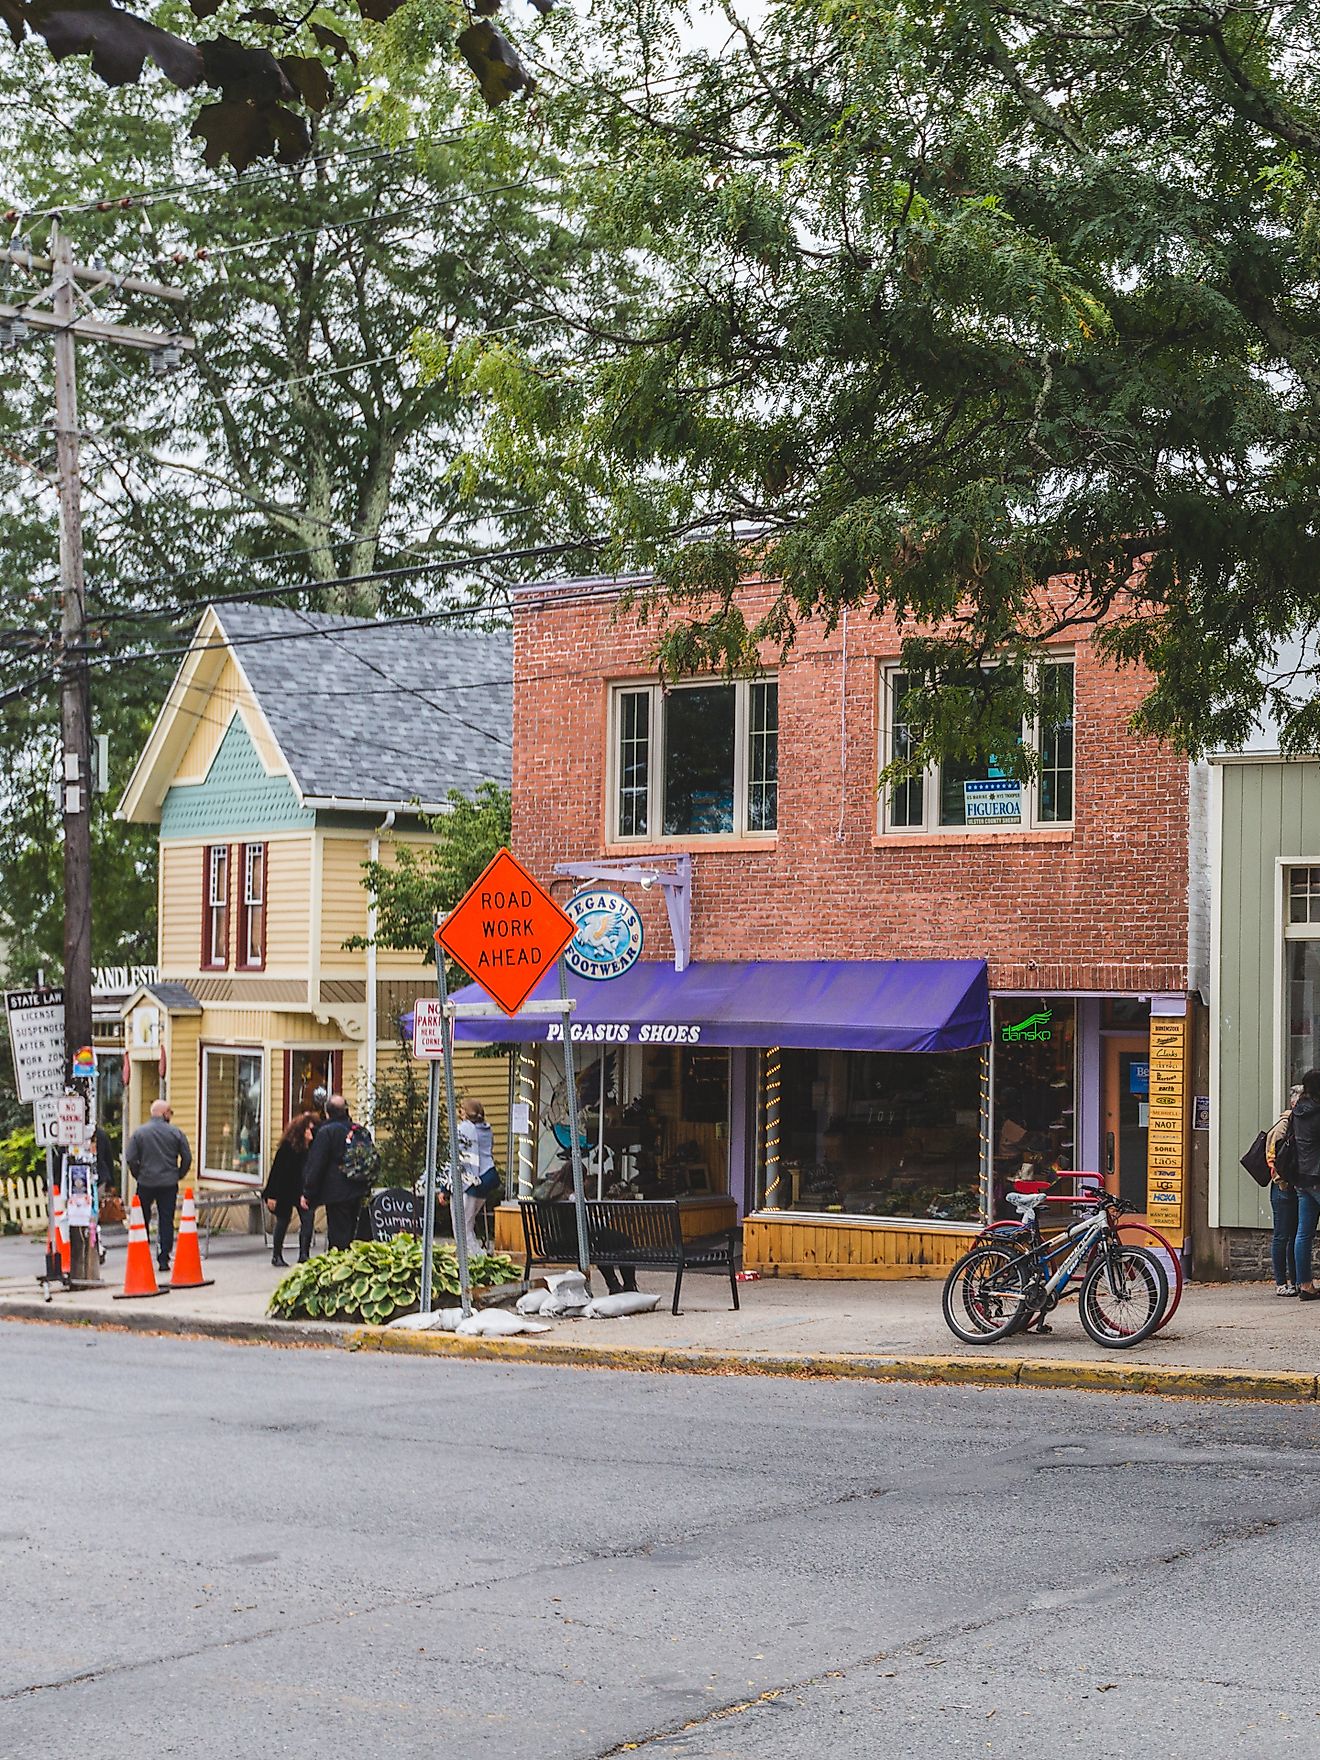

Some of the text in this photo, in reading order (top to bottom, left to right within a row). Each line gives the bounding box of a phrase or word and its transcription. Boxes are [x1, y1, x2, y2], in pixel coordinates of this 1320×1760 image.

[967, 801, 1021, 816] FIGUEROA
[481, 890, 532, 910] ROAD
[568, 896, 636, 927] EGASUS
[482, 919, 534, 938] WORK
[478, 947, 542, 967] AHEAD
[10, 992, 62, 1009] STATE LAW
[21, 1010, 55, 1021] LICENSE
[417, 1016, 441, 1027] PARKI
[638, 1024, 701, 1044] SHOES
[1002, 1021, 1051, 1041] dansko
[19, 1041, 46, 1051] AFTER
[48, 1052, 64, 1063] ZON
[1154, 1121, 1177, 1129] NAOT
[1156, 1181, 1173, 1190] UGG
[381, 1196, 414, 1213] Give
[1153, 1193, 1177, 1202] HOKA
